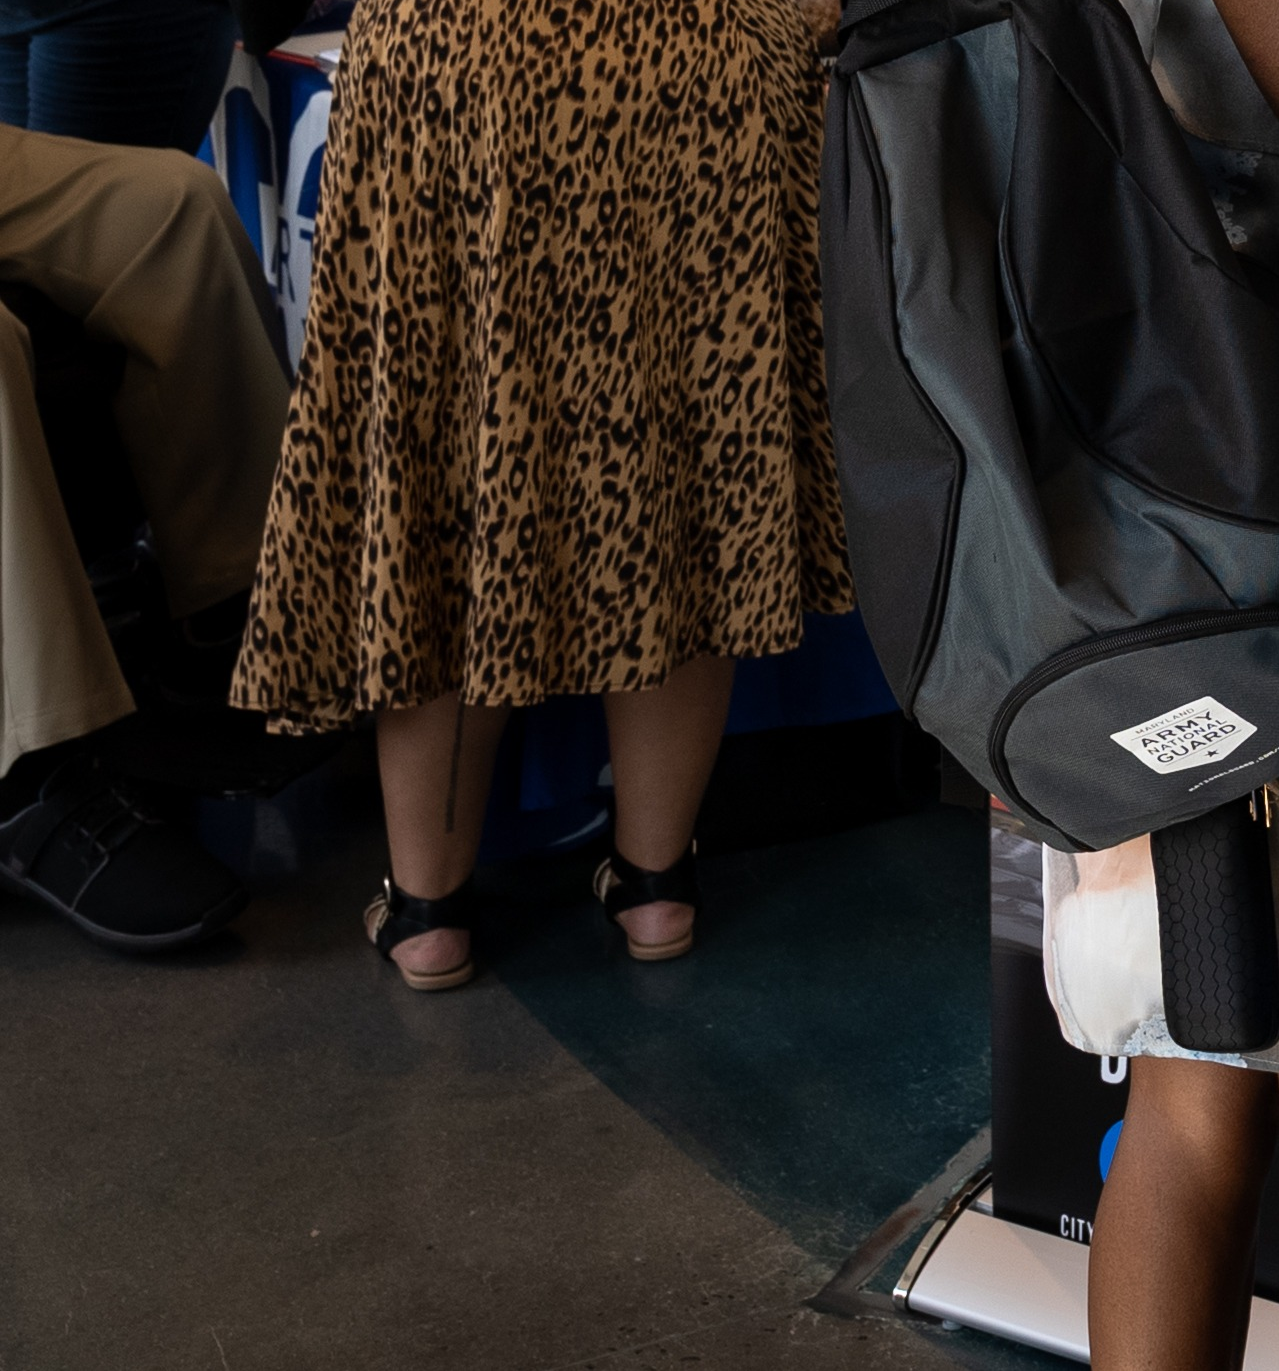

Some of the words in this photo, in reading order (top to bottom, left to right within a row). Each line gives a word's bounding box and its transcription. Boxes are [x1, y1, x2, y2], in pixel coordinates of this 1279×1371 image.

[1135, 707, 1195, 735] MARYLAND
[1141, 711, 1213, 748] ARMY
[1147, 719, 1228, 756] NATIONAL
[1156, 724, 1237, 763] GUARD
[1060, 1213, 1094, 1243] CITY
